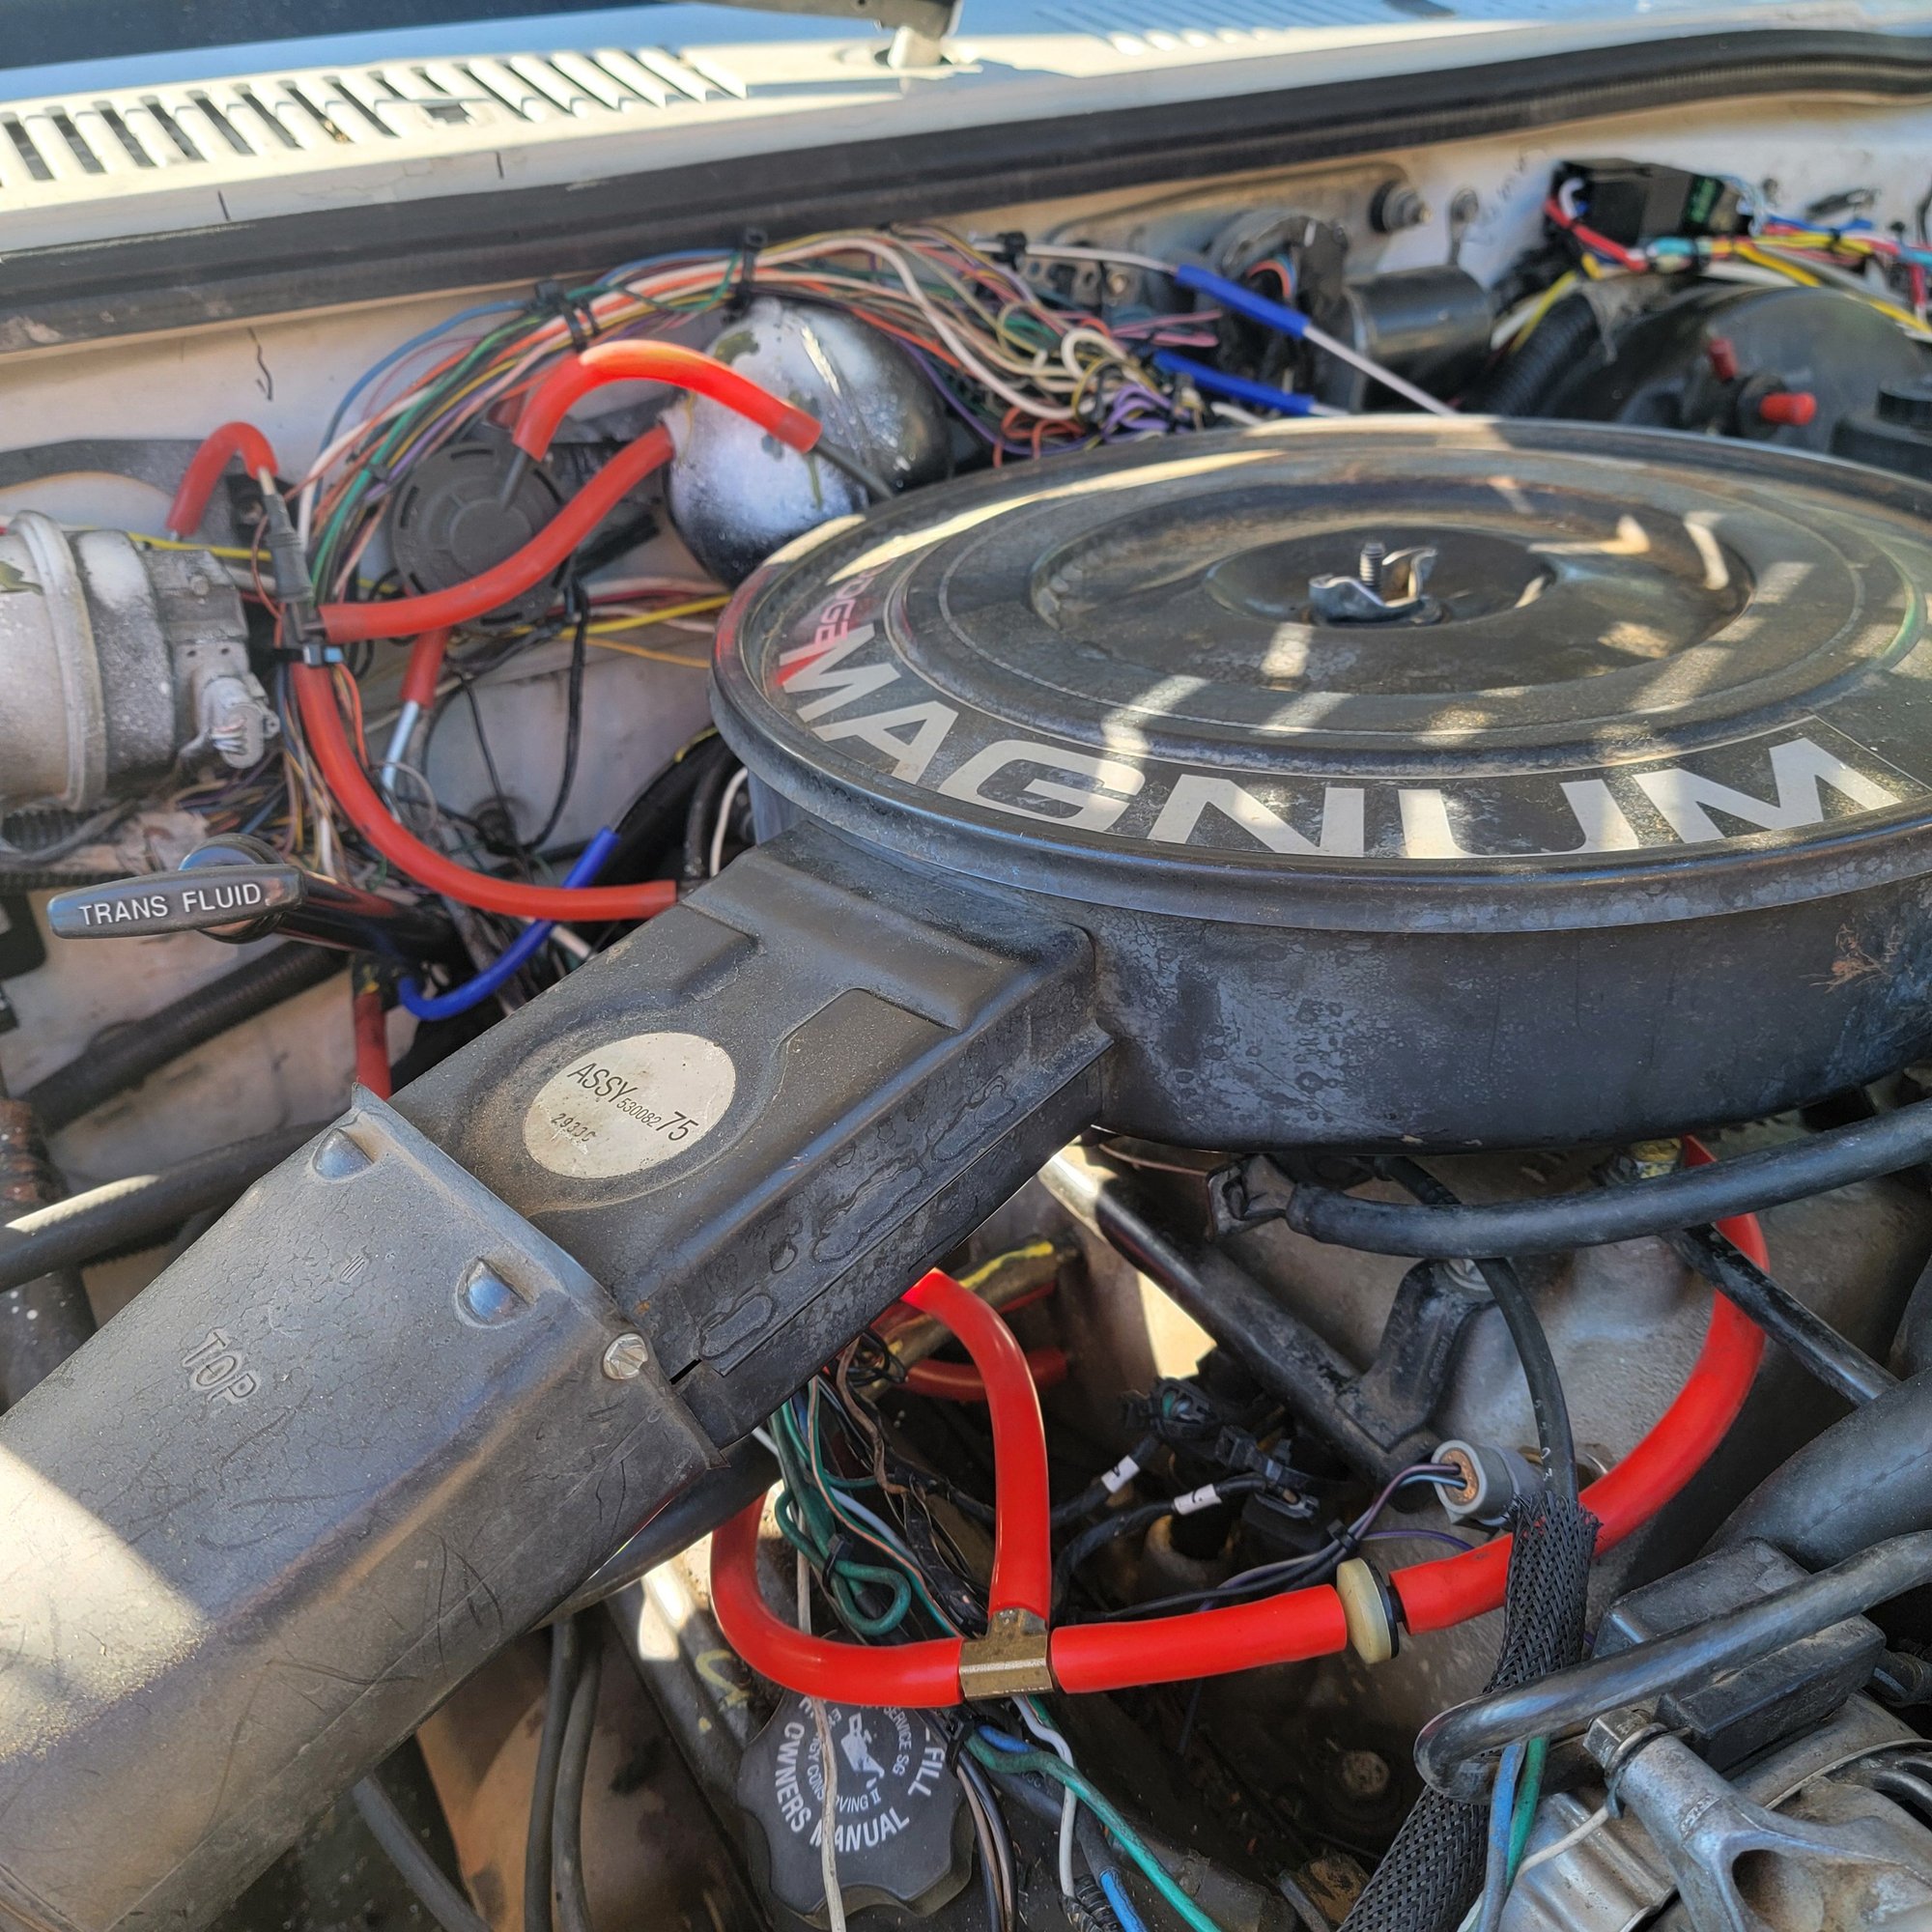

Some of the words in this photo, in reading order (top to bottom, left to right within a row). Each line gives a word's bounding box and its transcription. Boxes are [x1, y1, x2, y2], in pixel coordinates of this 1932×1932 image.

[779, 623, 1902, 860] MAGNUM
[78, 895, 168, 925] TRANS
[183, 883, 262, 913] FLUID
[567, 1063, 638, 1102] ASSY
[182, 1329, 261, 1404] TOP
[775, 1721, 811, 1833] OWNERS
[810, 1806, 910, 1853] MANUAL
[806, 1765, 869, 1812] CONSVING
[908, 1747, 946, 1796] FILL
